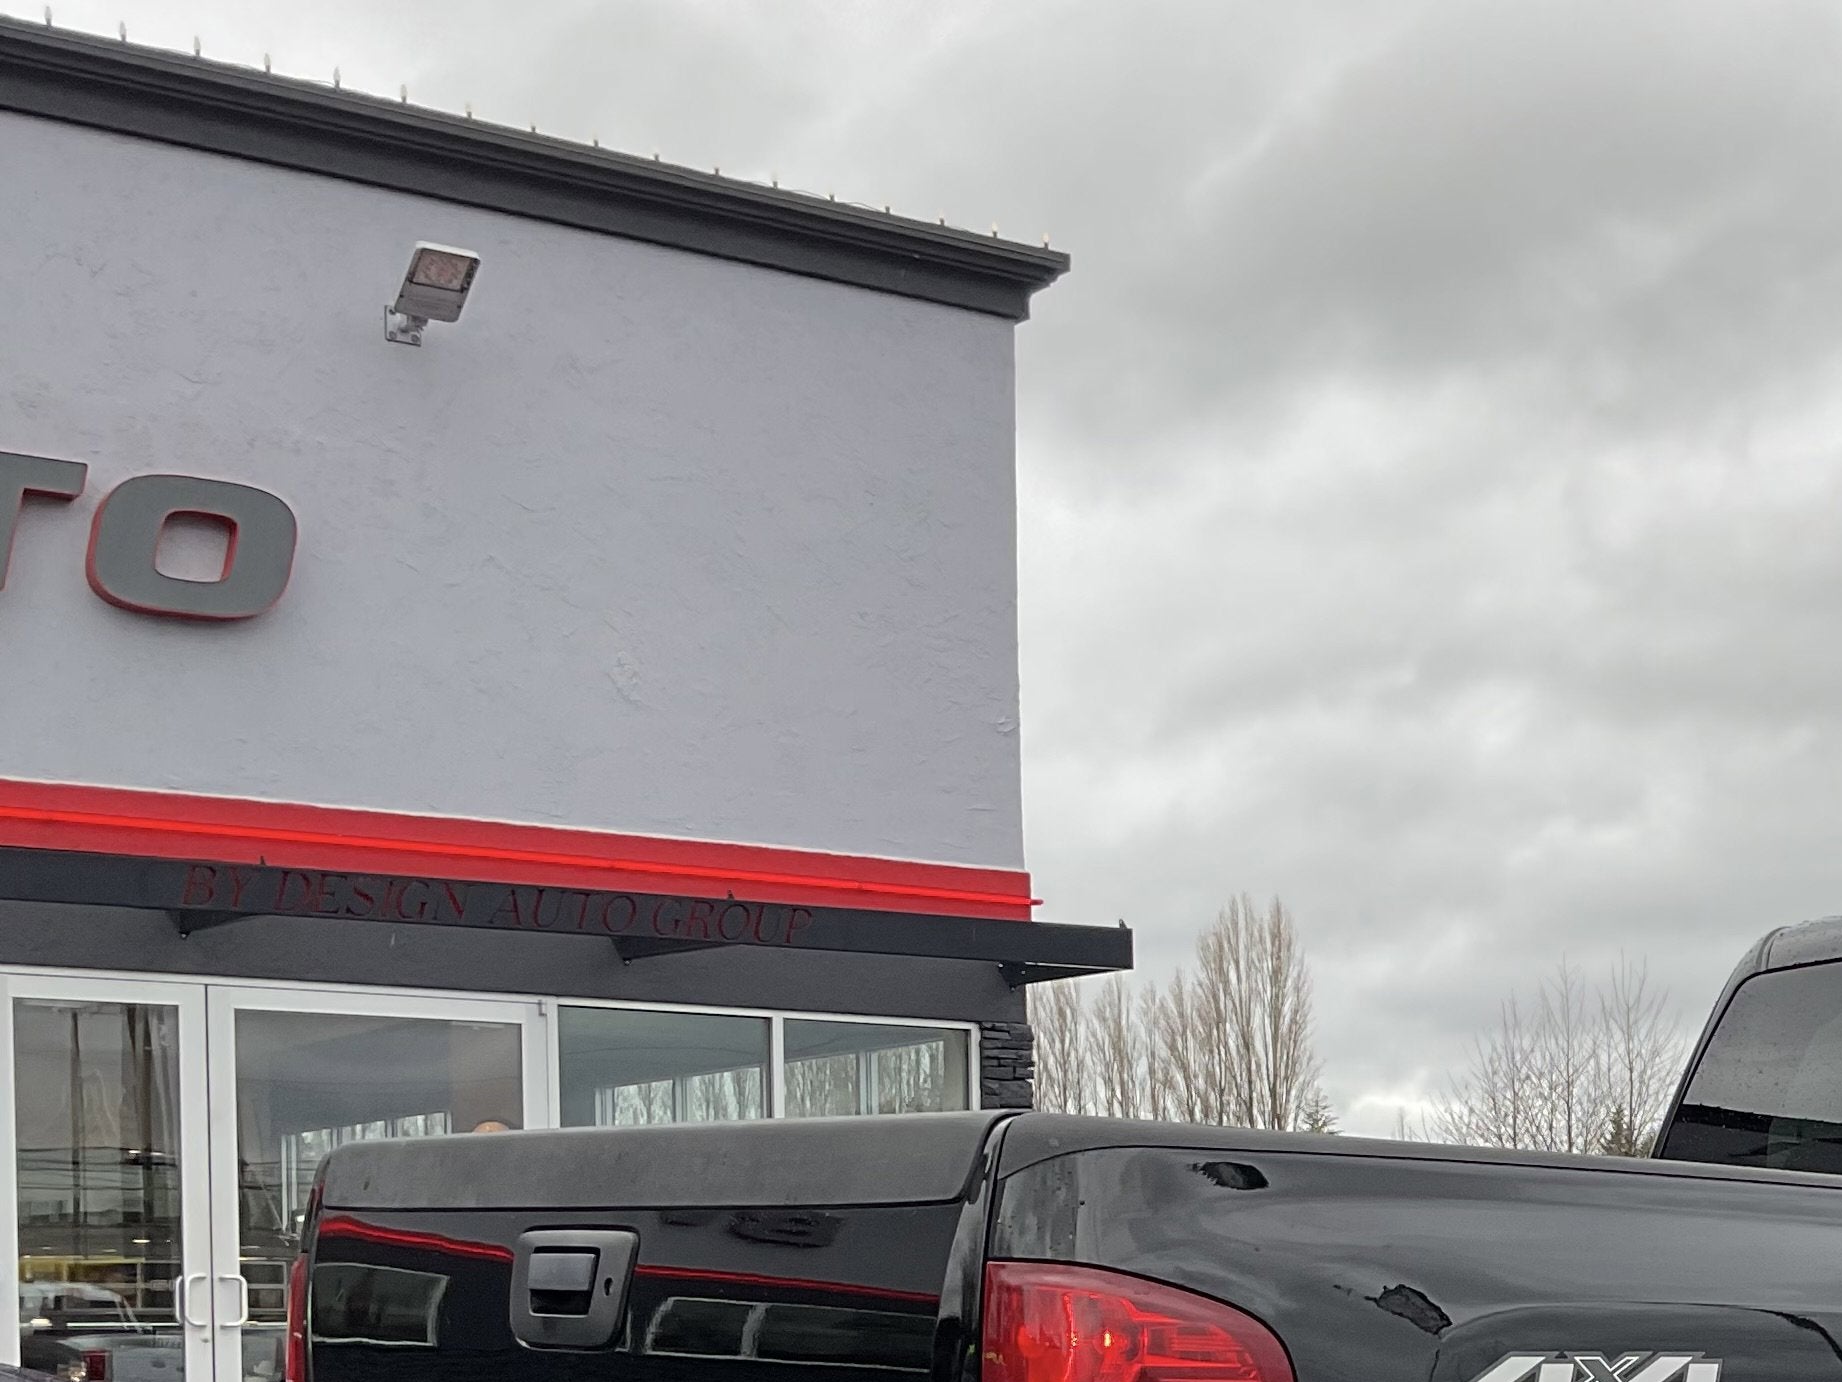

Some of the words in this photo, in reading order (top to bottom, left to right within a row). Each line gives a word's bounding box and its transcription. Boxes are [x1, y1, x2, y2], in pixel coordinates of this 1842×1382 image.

[181, 864, 251, 908] BY
[273, 869, 484, 921] DESIGN
[489, 887, 637, 933] AUTO
[652, 898, 812, 945] GROUP
